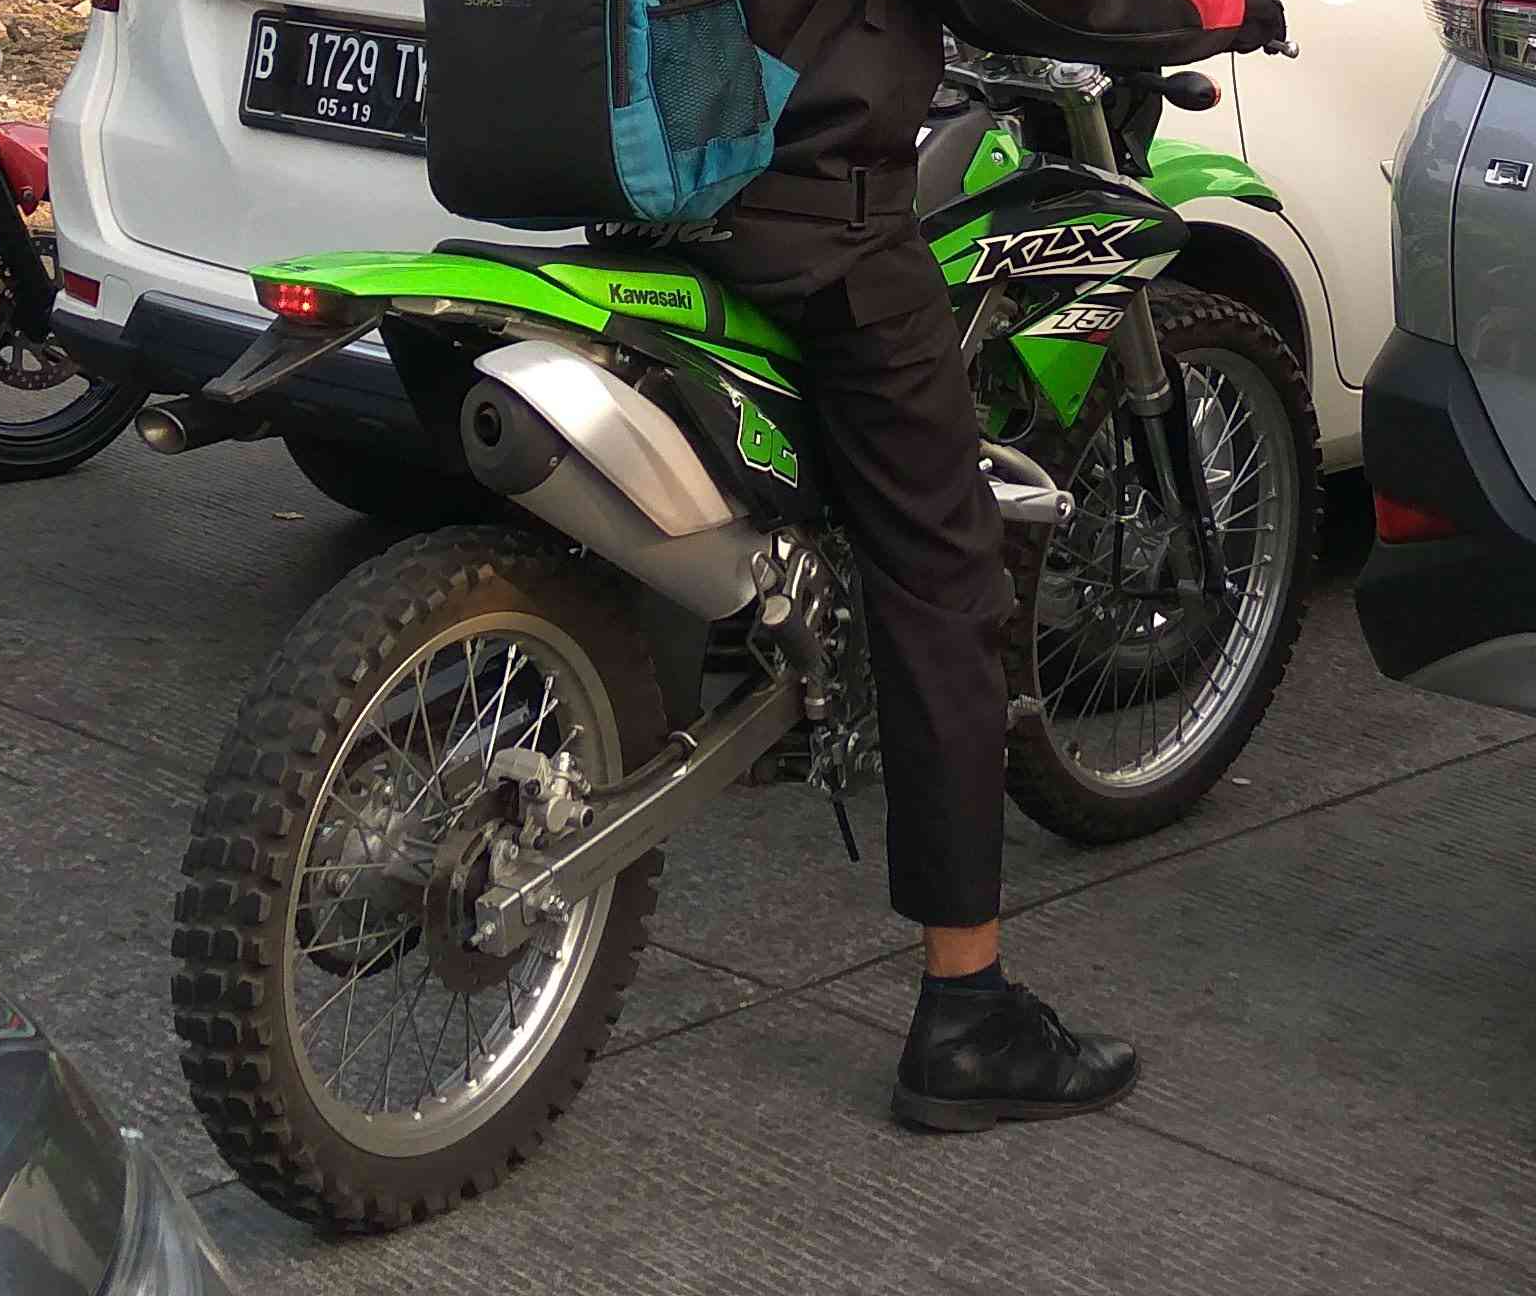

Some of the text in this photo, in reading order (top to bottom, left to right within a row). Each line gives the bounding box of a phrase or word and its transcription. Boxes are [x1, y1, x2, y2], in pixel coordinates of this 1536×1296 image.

[254, 25, 278, 80] B
[305, 31, 379, 94] 1729
[966, 218, 1145, 284] KLX
[608, 282, 693, 311] Kawasaki
[1056, 308, 1125, 330] 150
